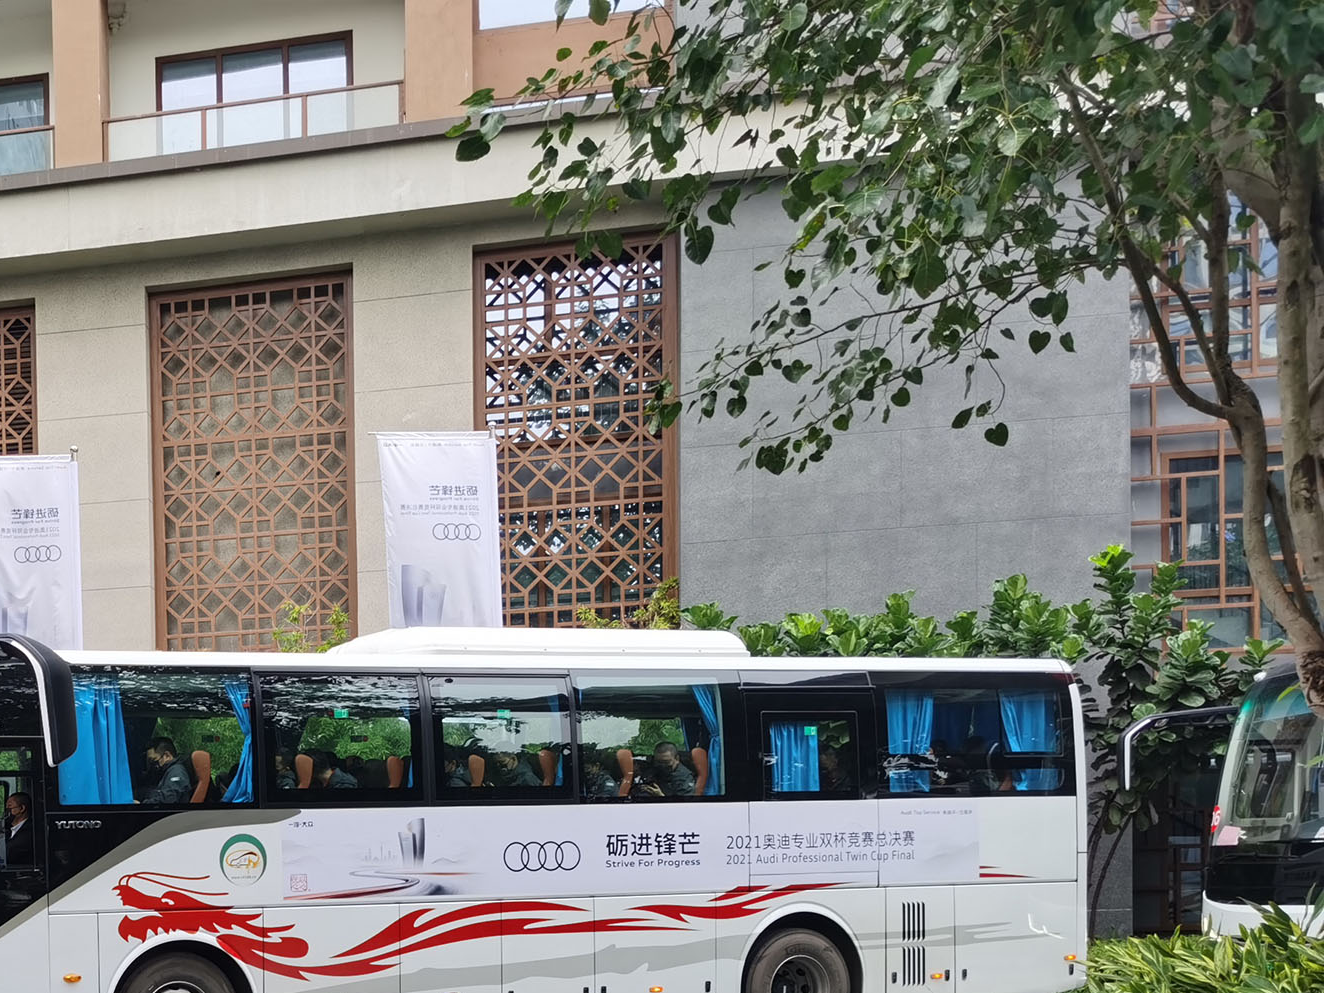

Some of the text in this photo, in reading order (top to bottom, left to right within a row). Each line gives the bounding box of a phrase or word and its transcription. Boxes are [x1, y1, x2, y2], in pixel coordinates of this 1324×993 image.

[55, 820, 101, 829] YUTONG
[606, 832, 701, 857] 砺进锋芒
[726, 831, 915, 850] 2021奥迪专业双杯竞赛总决赛
[606, 858, 701, 868] Strive For Progress
[726, 849, 915, 865] 2021 Audi Professional Twin Cup Final
